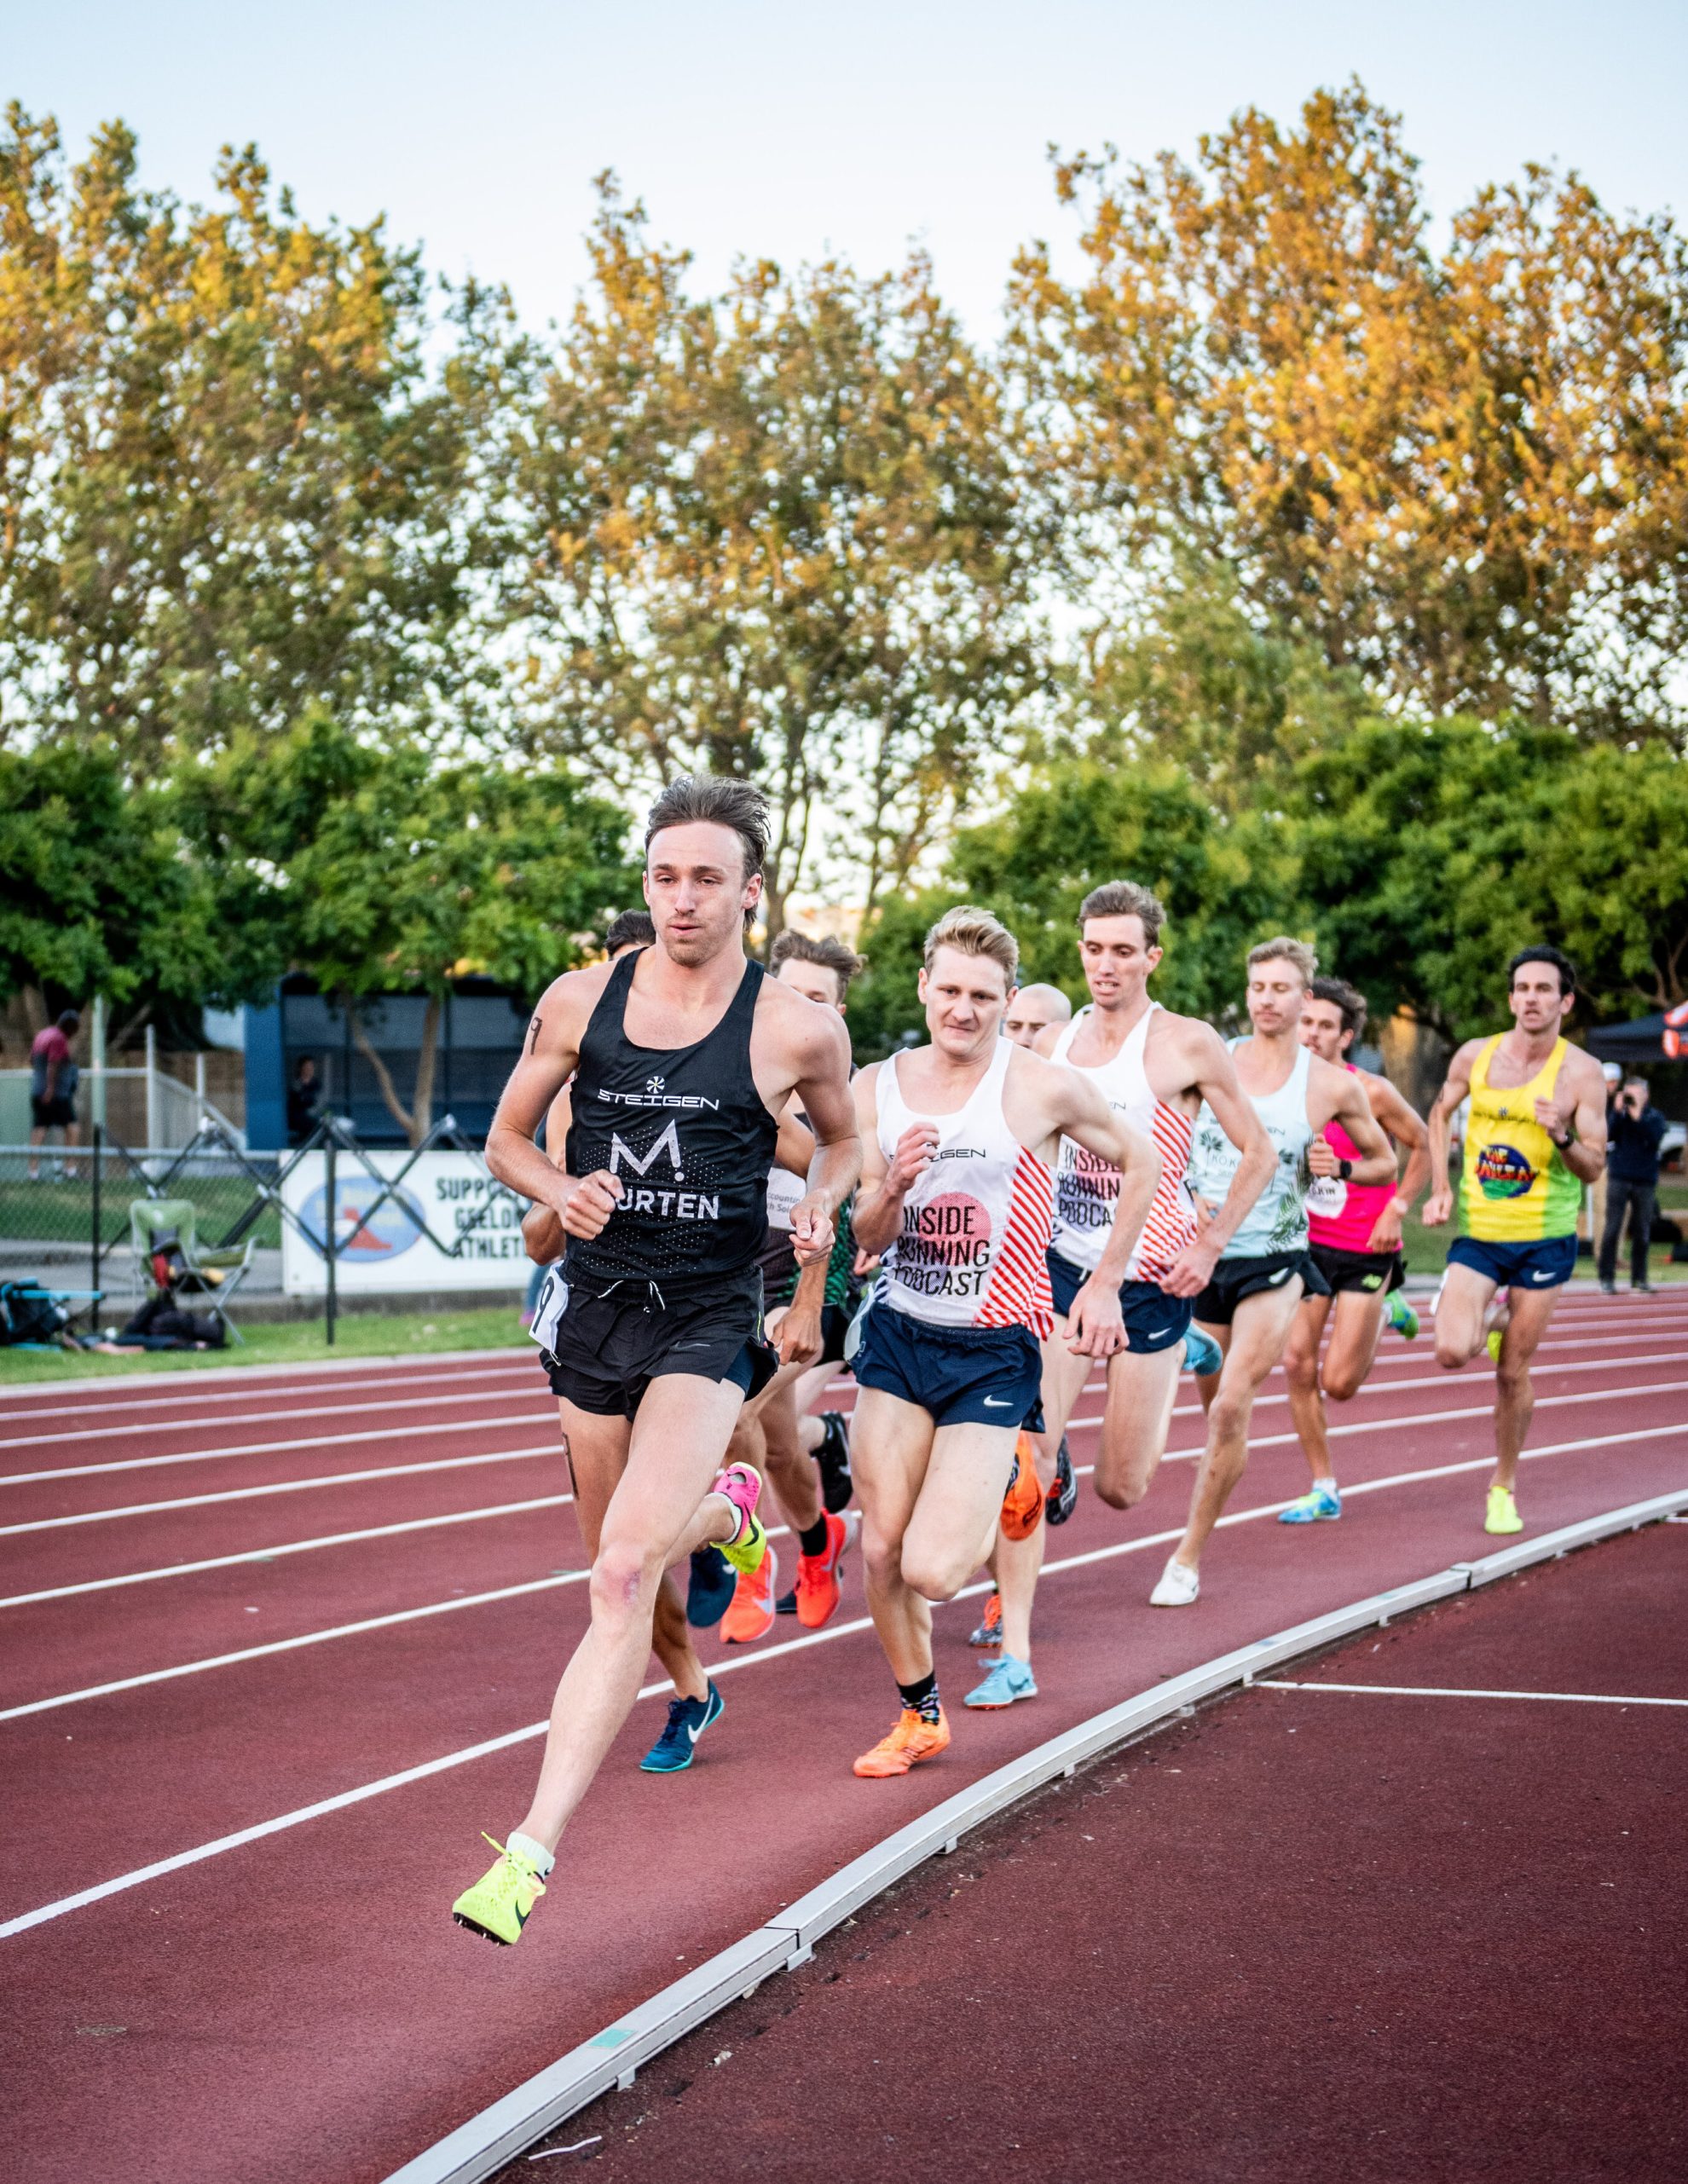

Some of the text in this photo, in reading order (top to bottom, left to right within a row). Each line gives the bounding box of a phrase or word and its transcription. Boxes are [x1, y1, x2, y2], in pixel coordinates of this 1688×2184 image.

[598, 1089, 720, 1111] STEIGEN
[616, 1189, 719, 1220] URTEN
[767, 1193, 801, 1203] ccountin
[904, 1205, 976, 1235] INSIDE
[1059, 1199, 1113, 1227] PODCA
[454, 1236, 521, 1258] ATHLET
